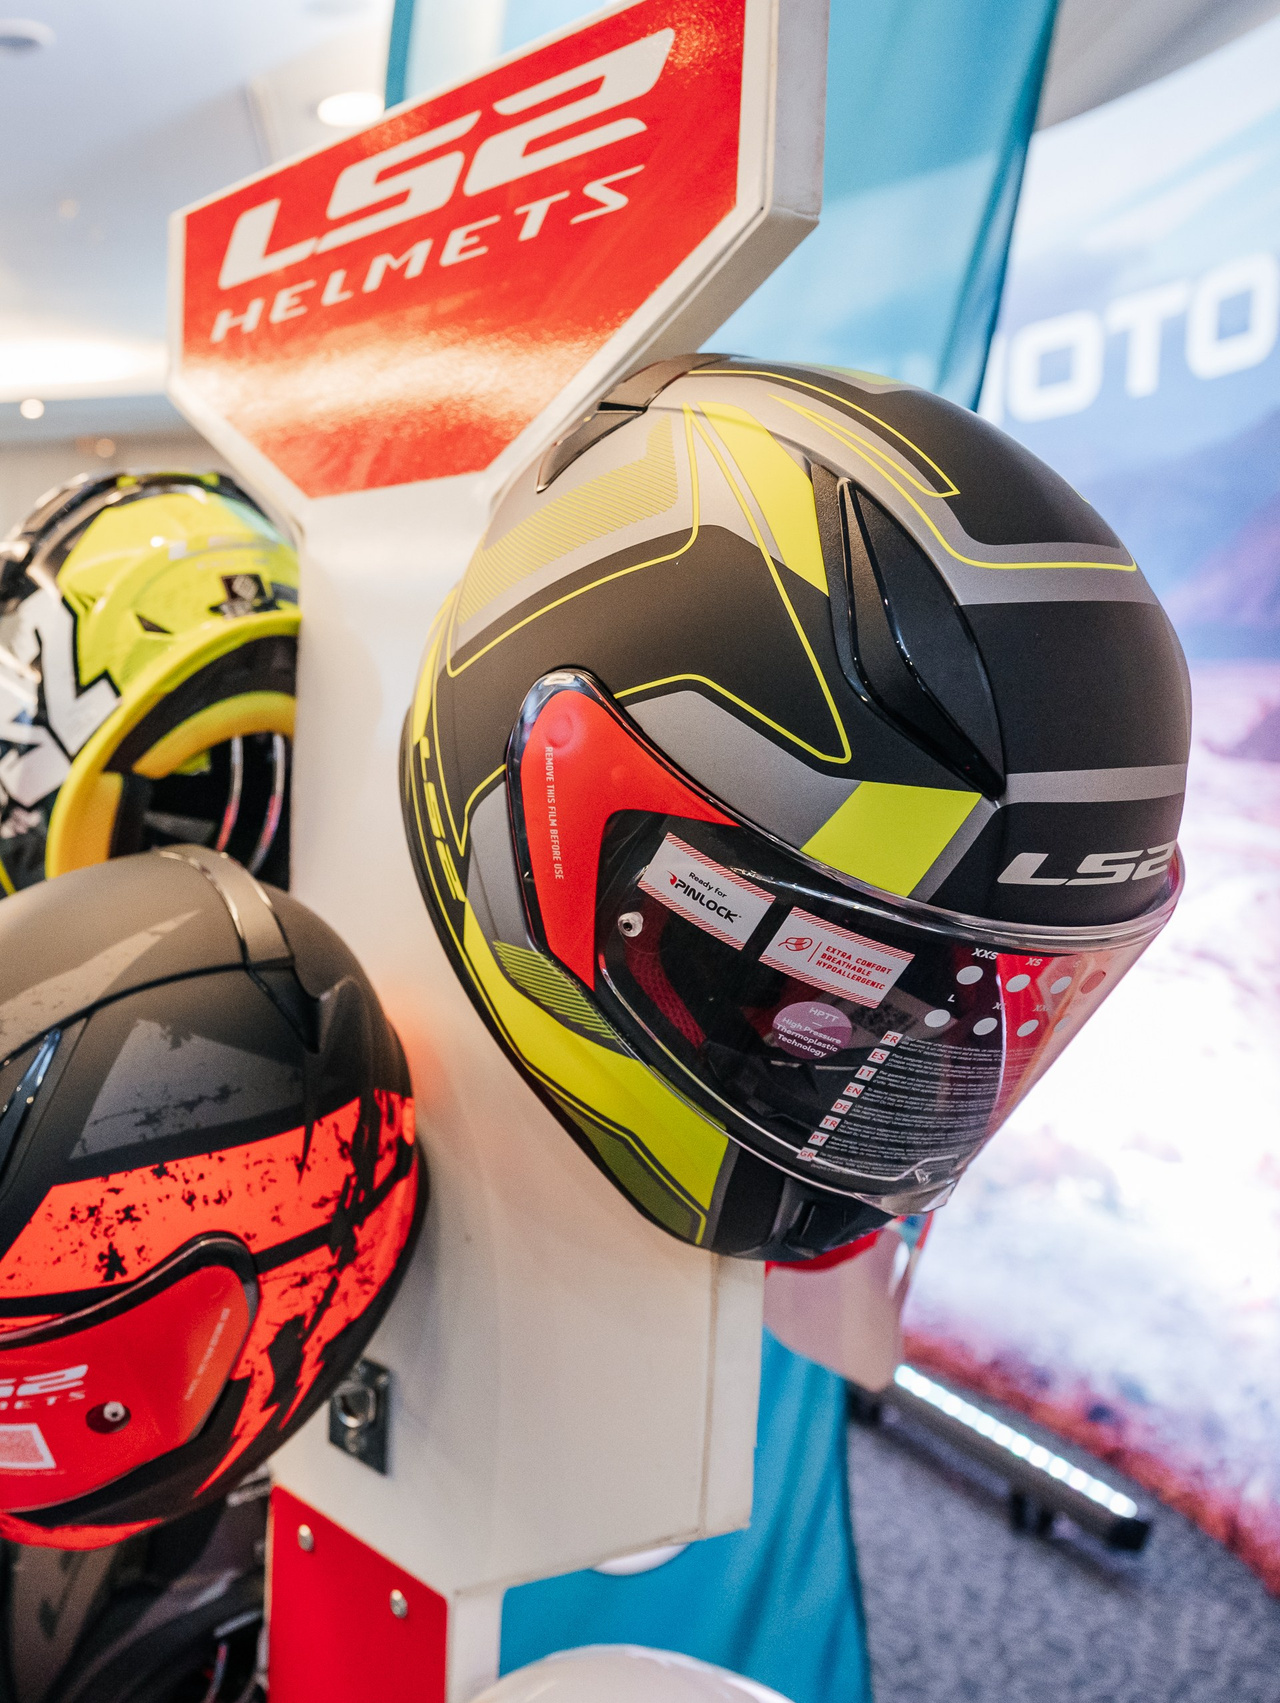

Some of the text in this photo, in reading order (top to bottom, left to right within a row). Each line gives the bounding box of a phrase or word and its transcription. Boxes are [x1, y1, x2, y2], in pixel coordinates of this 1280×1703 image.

[218, 27, 676, 291] LS2
[210, 164, 645, 343] HELMETS
[545, 746, 564, 879] REMOVE THIS FILM BEFORE USE
[997, 839, 1177, 886] LS2
[688, 872, 727, 898] Ready for
[674, 879, 738, 923] PINLOCK
[820, 952, 873, 977] BREATHABLE
[825, 945, 893, 975] EXTRA COMFORT
[971, 948, 998, 960] XXS
[1025, 957, 1043, 966] XS
[815, 959, 886, 990] HYPOALLERGENIC
[809, 1007, 839, 1023] HPTT
[776, 1023, 838, 1052] Thermoplastic
[782, 1016, 842, 1045] High Pressure
[883, 1034, 899, 1044] FR
[778, 1033, 827, 1058] Technology
[871, 1051, 887, 1061] ES
[858, 1068, 874, 1078] IT
[846, 1085, 862, 1095] EN
[834, 1102, 850, 1112] DE
[822, 1118, 838, 1128] TR
[810, 1133, 826, 1143] PT
